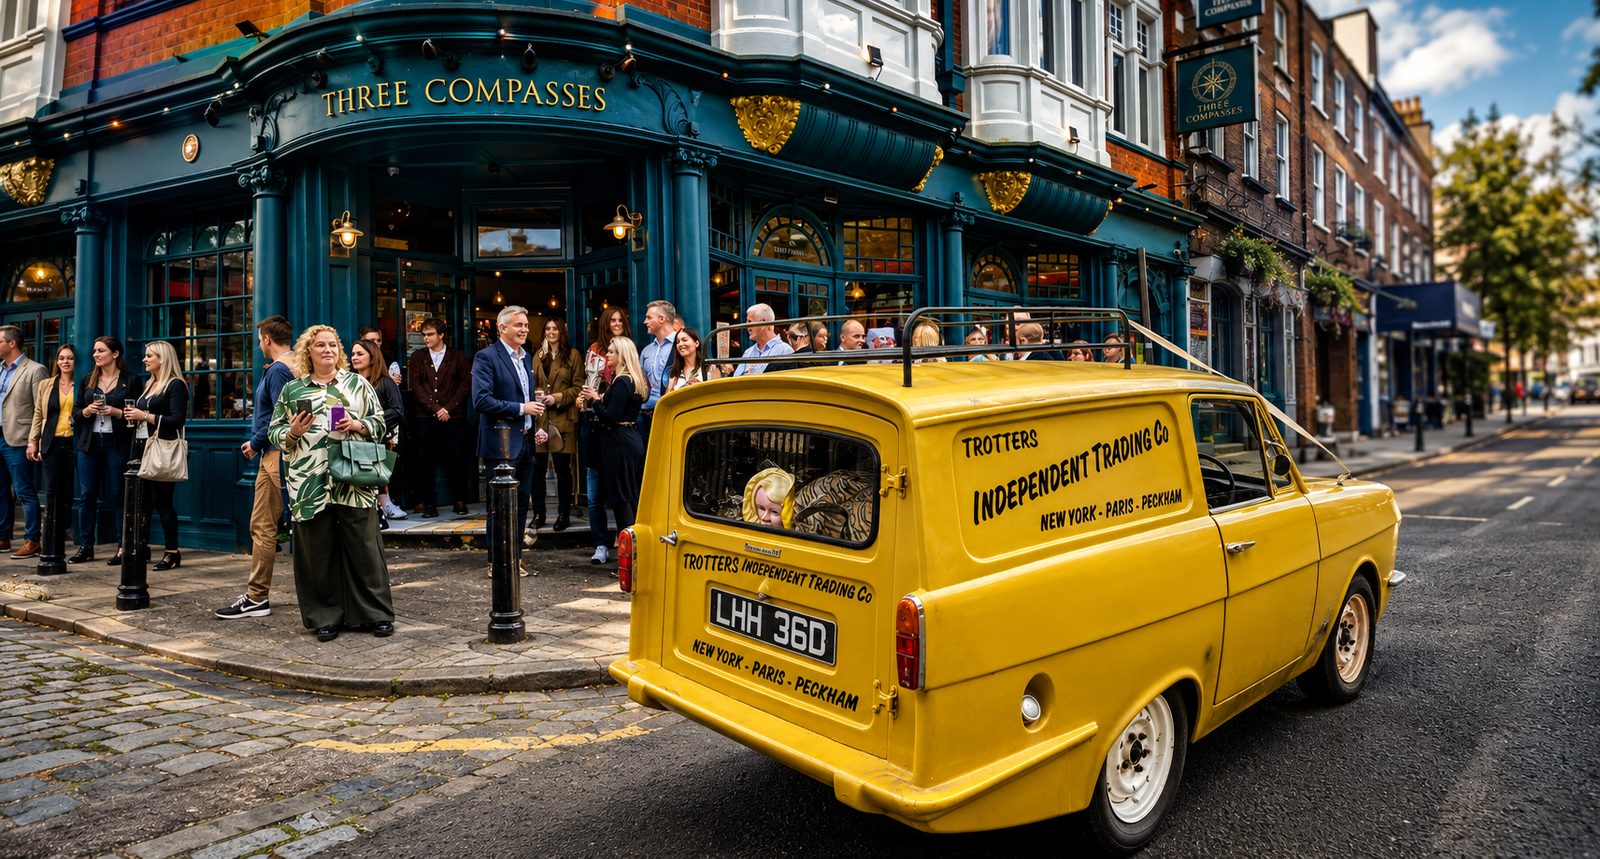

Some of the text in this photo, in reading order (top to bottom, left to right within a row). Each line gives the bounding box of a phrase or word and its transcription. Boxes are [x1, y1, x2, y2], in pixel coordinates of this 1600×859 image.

[321, 78, 607, 117] THREE COMPASSES
[1186, 106, 1242, 123] COMPASSES
[1197, 99, 1229, 112] THREE
[962, 428, 1038, 458] TROTTERS
[973, 419, 1169, 525] INDEPENDENT TRADING Co
[1040, 512, 1066, 532] NEW
[1068, 505, 1097, 526] YORK
[1105, 498, 1134, 519] PARIS
[1141, 488, 1183, 510] PECKHAM
[683, 553, 873, 604] TROTTERS INDEPENDENT TRADING Co
[716, 593, 827, 656] LHH 36D
[692, 639, 716, 658] NEW
[717, 647, 744, 670] YORK
[751, 660, 786, 685] PARIS
[794, 676, 859, 712] PECKHAM
